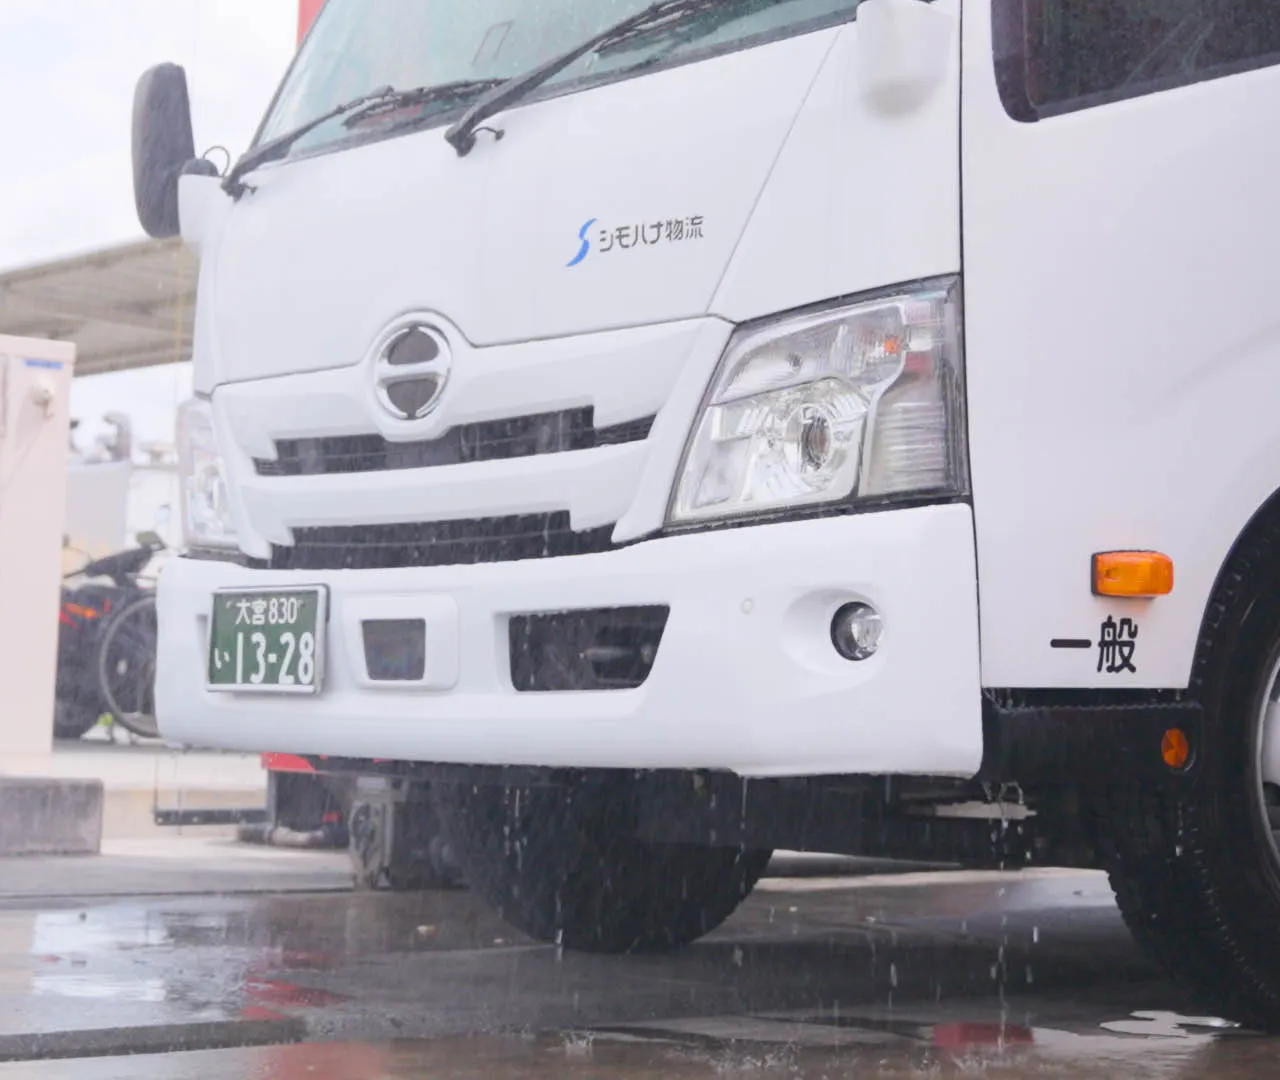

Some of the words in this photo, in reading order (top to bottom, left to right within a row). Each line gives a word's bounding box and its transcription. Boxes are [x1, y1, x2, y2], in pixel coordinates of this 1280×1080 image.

[599, 215, 704, 252] シモハナ物流
[1049, 614, 1139, 673] 一般
